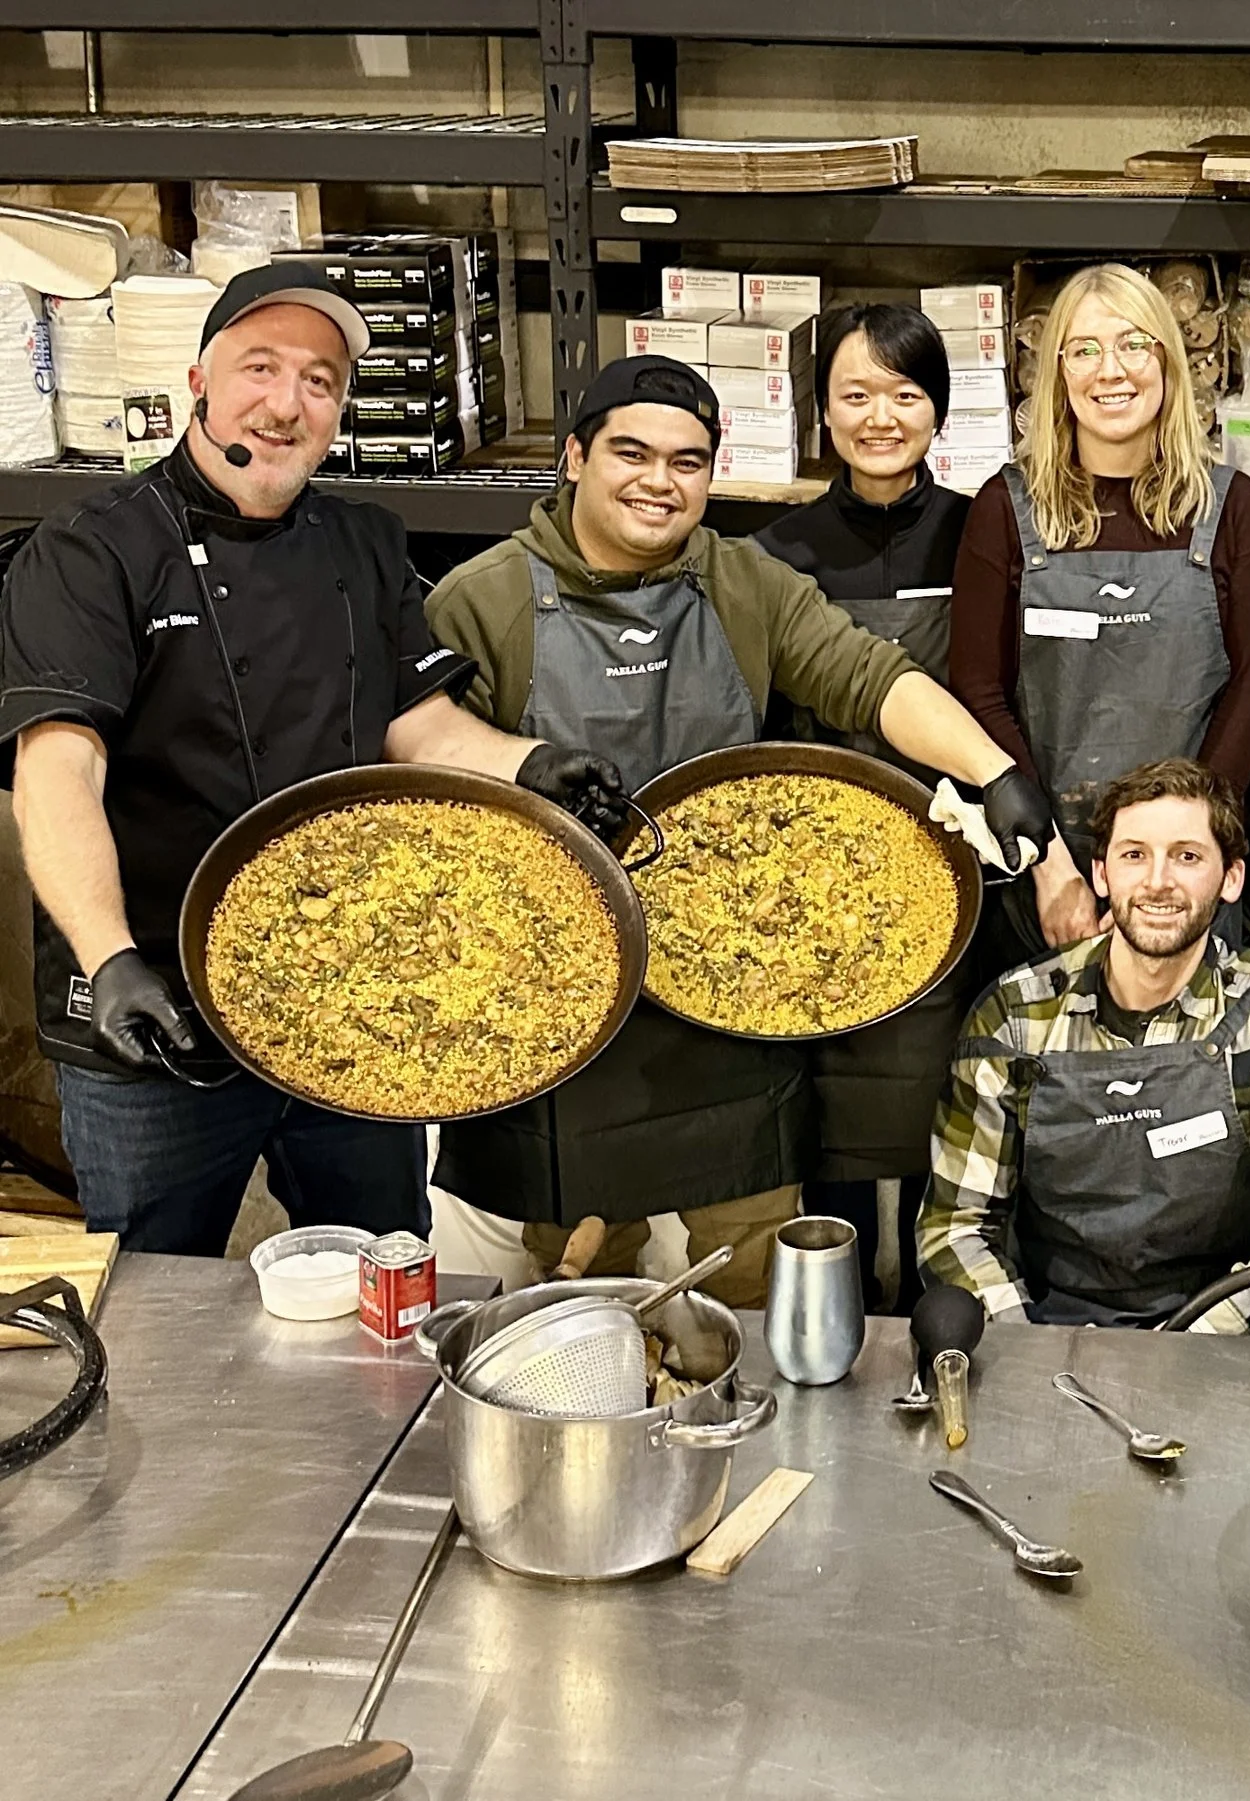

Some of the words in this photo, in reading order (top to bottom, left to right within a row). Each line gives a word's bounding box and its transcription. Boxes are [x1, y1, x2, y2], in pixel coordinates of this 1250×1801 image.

[1098, 615, 1123, 624] ELLA
[1123, 612, 1152, 623] GUYS
[605, 663, 647, 677] PAELLA
[1095, 1111, 1134, 1126] PAELLA
[1134, 1108, 1162, 1120] GUYS
